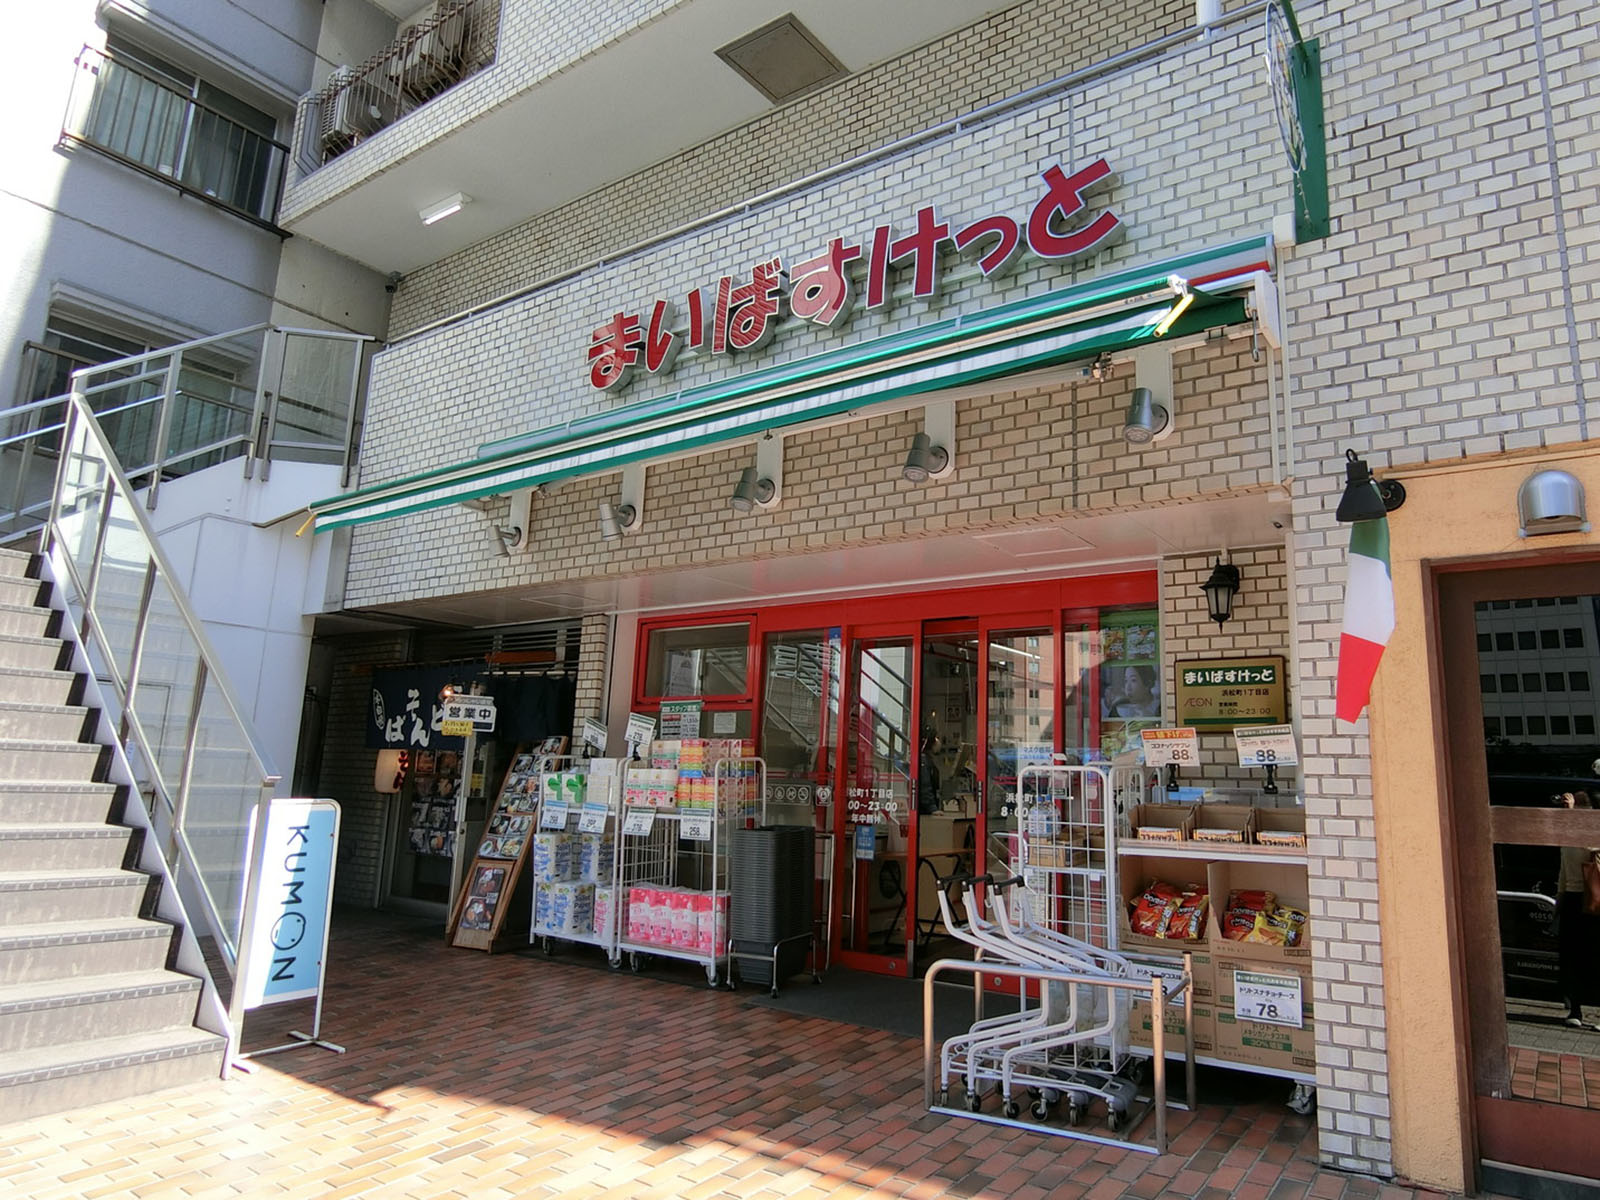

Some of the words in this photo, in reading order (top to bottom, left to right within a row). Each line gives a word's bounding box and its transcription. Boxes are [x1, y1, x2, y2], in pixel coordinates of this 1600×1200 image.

[587, 157, 1121, 391] まいばすけっと
[1184, 668, 1274, 685] まいばすけっと
[1221, 687, 1270, 697] 浜松町1丁目店
[448, 706, 491, 720] 営業中
[1172, 749, 1190, 761] 88
[1255, 749, 1277, 763] 88
[271, 825, 311, 982] KUMON
[1256, 1003, 1279, 1018] 78
